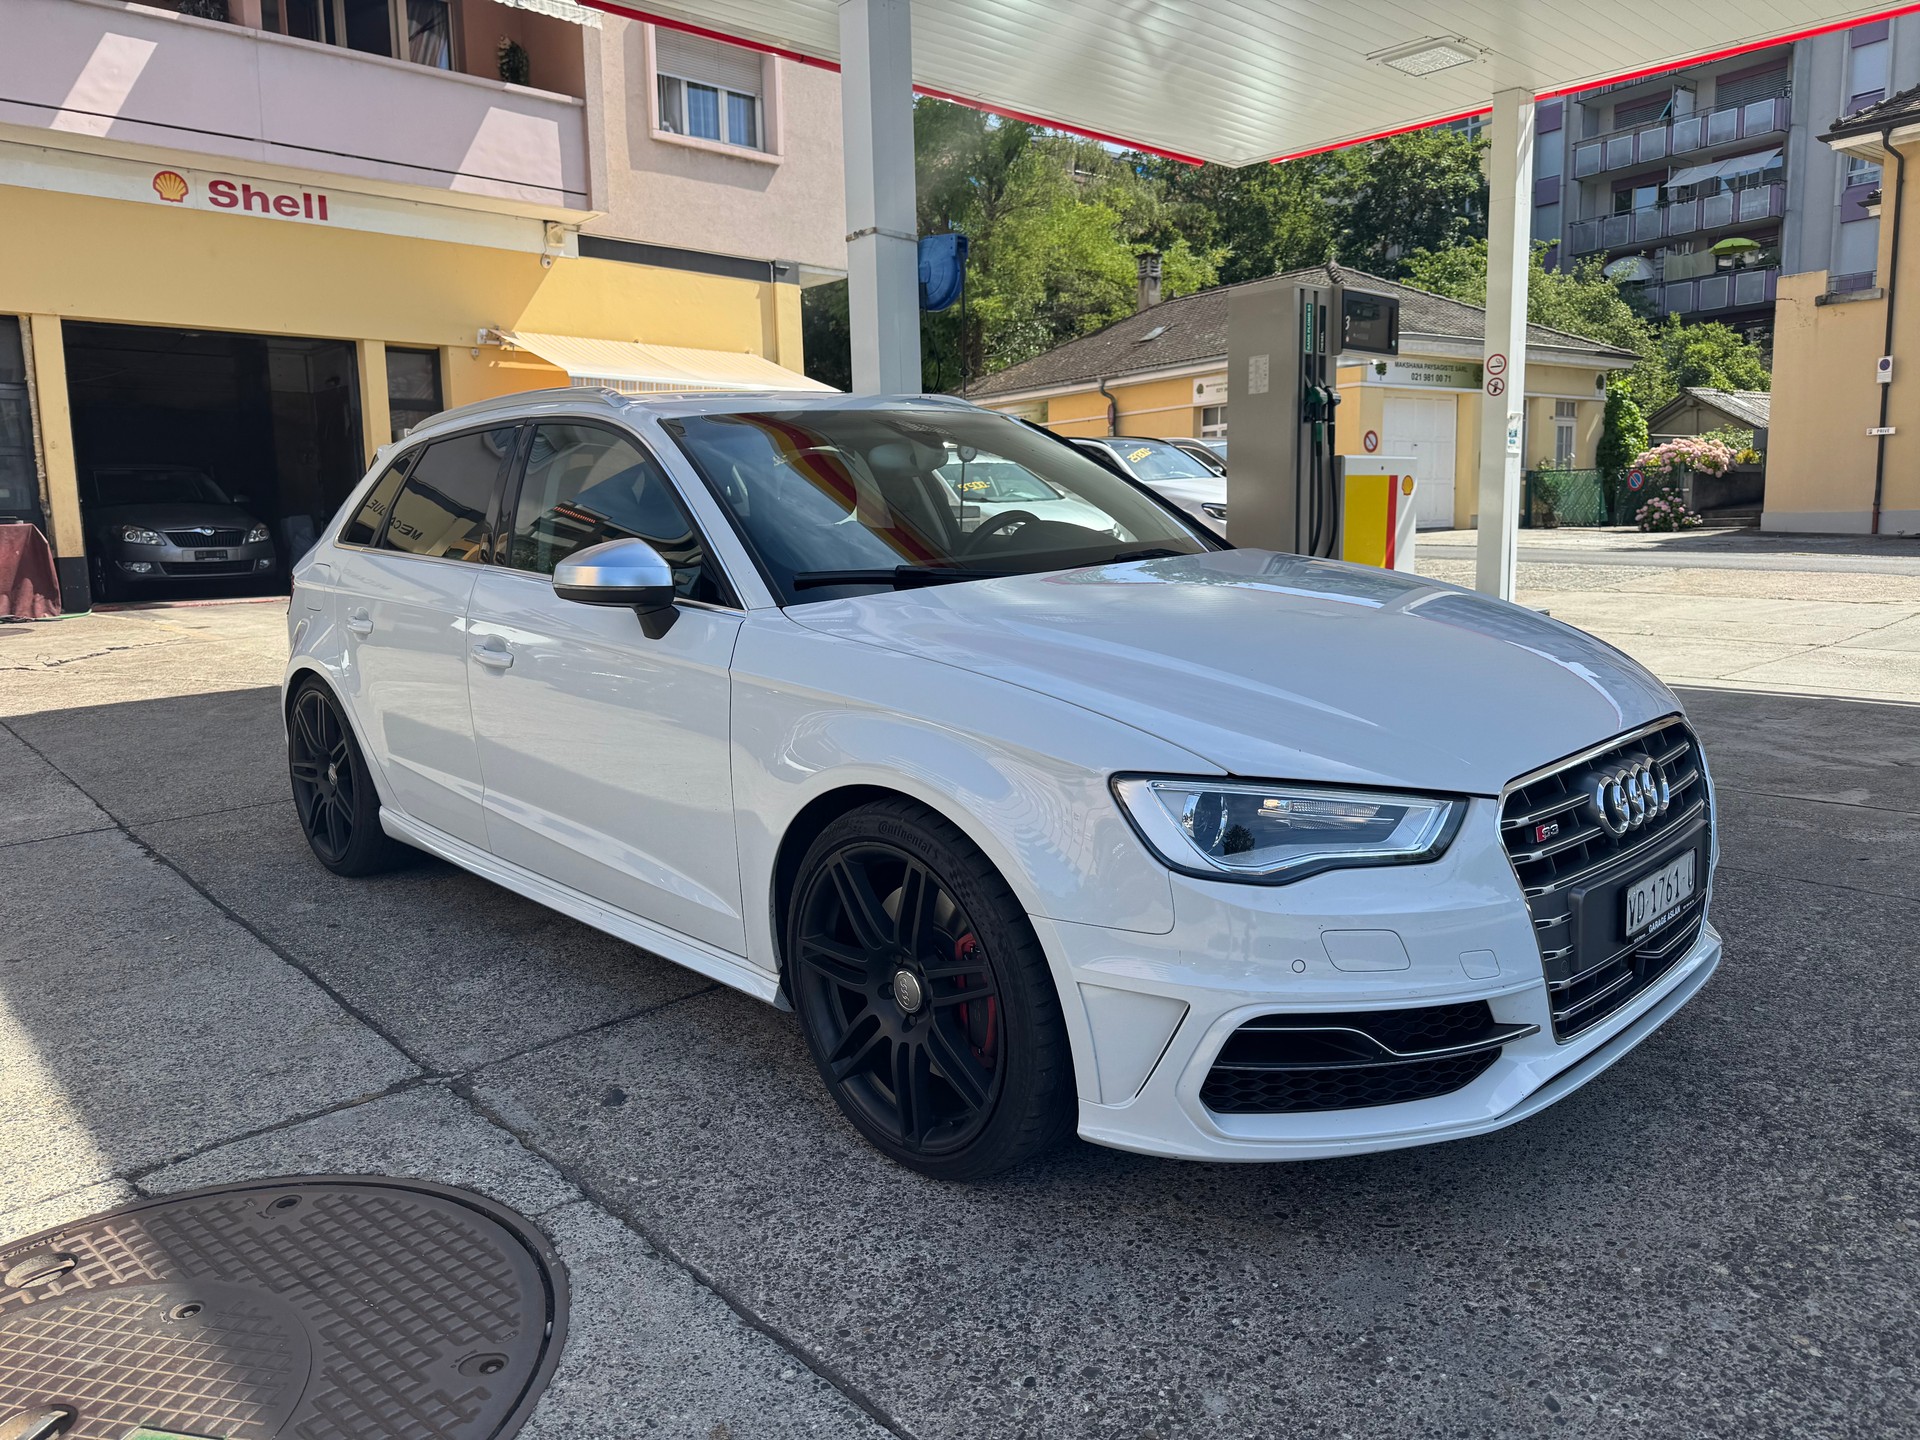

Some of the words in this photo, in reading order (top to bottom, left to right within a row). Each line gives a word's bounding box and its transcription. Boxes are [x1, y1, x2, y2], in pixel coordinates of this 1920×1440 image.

[208, 180, 329, 221] Shell
[1344, 315, 1351, 330] 3
[1394, 361, 1423, 370] MAKSHANA
[1424, 363, 1454, 372] PAYSAGISTE
[1411, 372, 1422, 381] 021
[1423, 373, 1434, 382] 981
[1435, 374, 1443, 382] 00
[878, 821, 932, 854] Continental
[1648, 914, 1667, 933] GARAGE
